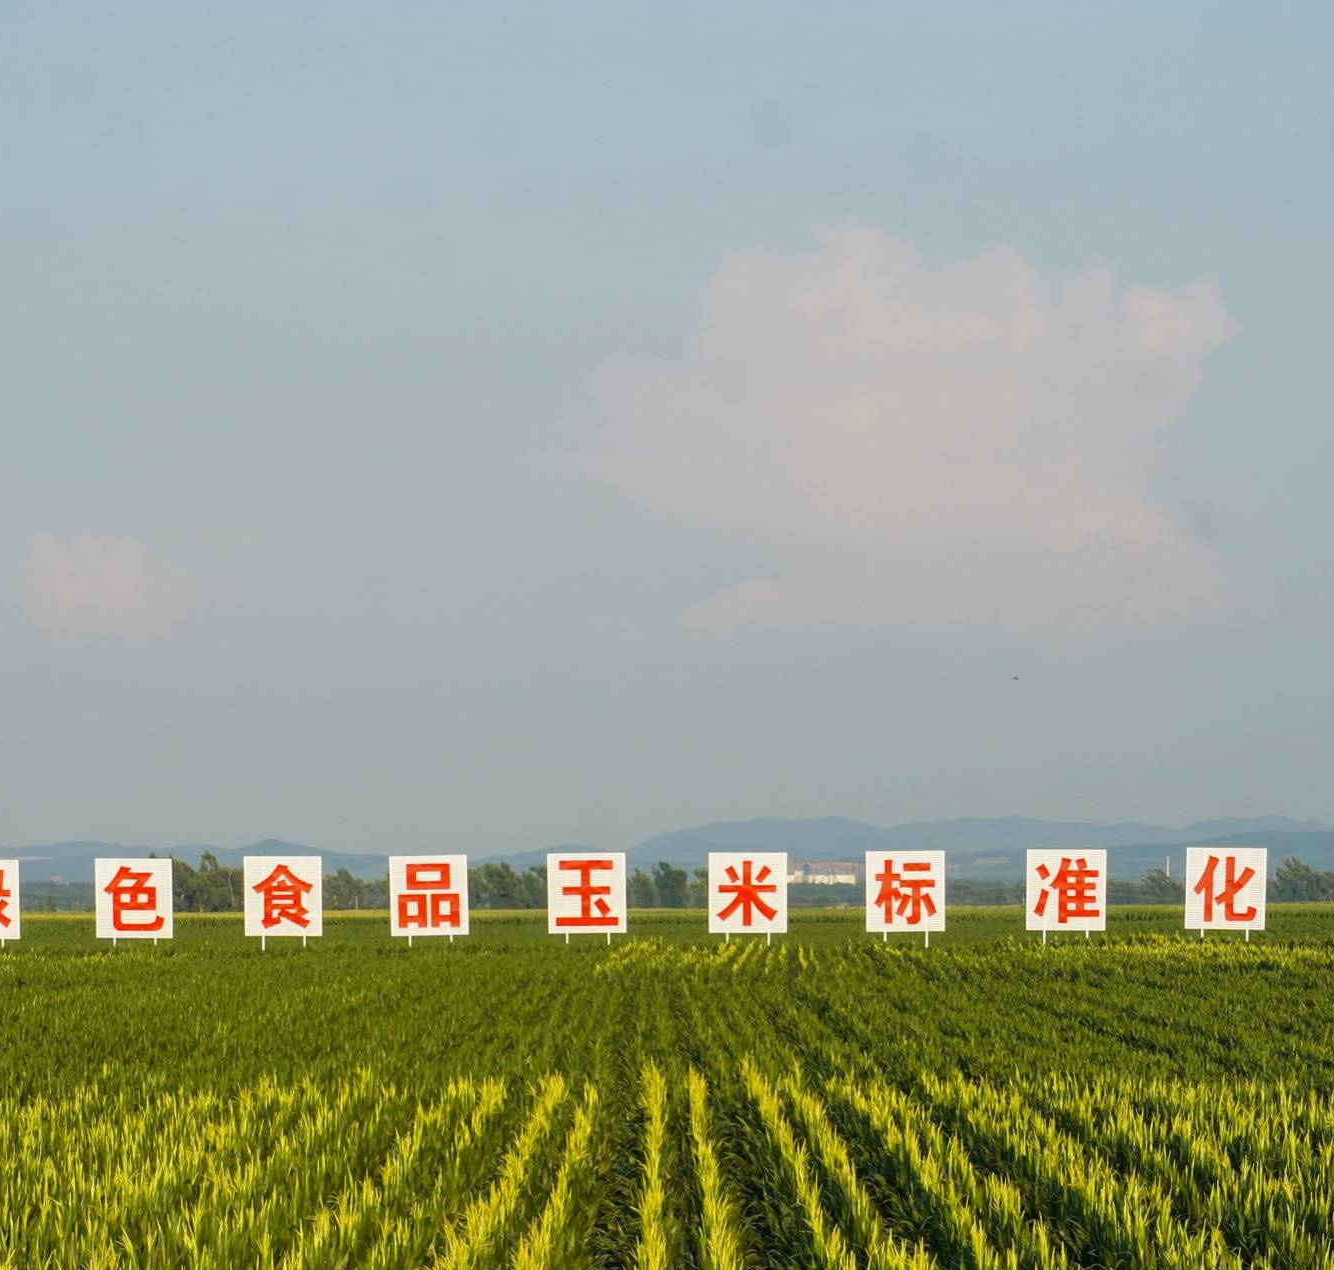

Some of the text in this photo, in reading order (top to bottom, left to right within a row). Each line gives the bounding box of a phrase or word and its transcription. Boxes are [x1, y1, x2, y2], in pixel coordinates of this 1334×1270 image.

[104, 866, 164, 932] 色
[253, 864, 313, 928] 食
[397, 862, 461, 929] 品
[555, 859, 620, 927] 玉
[718, 860, 777, 927] 米
[875, 859, 936, 925] 标
[1034, 857, 1100, 924] 准
[1194, 856, 1257, 922] 化
